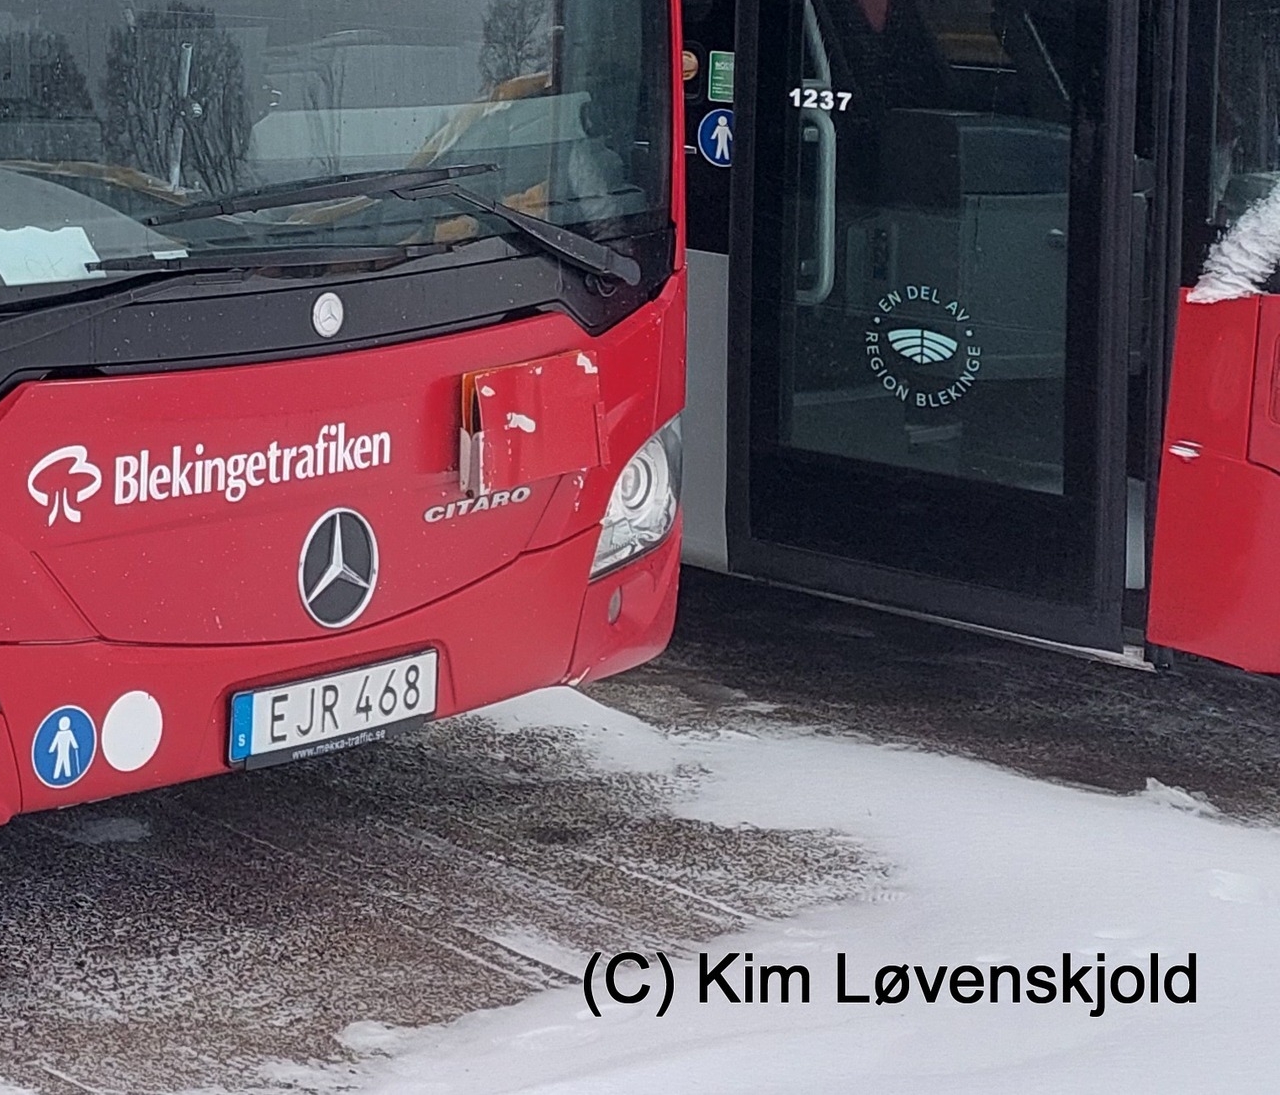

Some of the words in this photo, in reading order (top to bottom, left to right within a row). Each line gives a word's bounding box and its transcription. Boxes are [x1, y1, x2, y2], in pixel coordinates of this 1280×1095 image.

[789, 87, 853, 112] 1237
[878, 290, 902, 313] EN
[906, 285, 941, 305] DEL
[945, 301, 971, 322] AV
[865, 331, 910, 402] REGION
[915, 345, 982, 408] BLEKINGE
[113, 422, 391, 506] Blekingetrafiken
[423, 486, 532, 523] CITARO
[269, 683, 340, 745] EJR
[355, 663, 421, 723] 468
[237, 733, 247, 748] S
[290, 727, 387, 761] www.mekka-traffic.se
